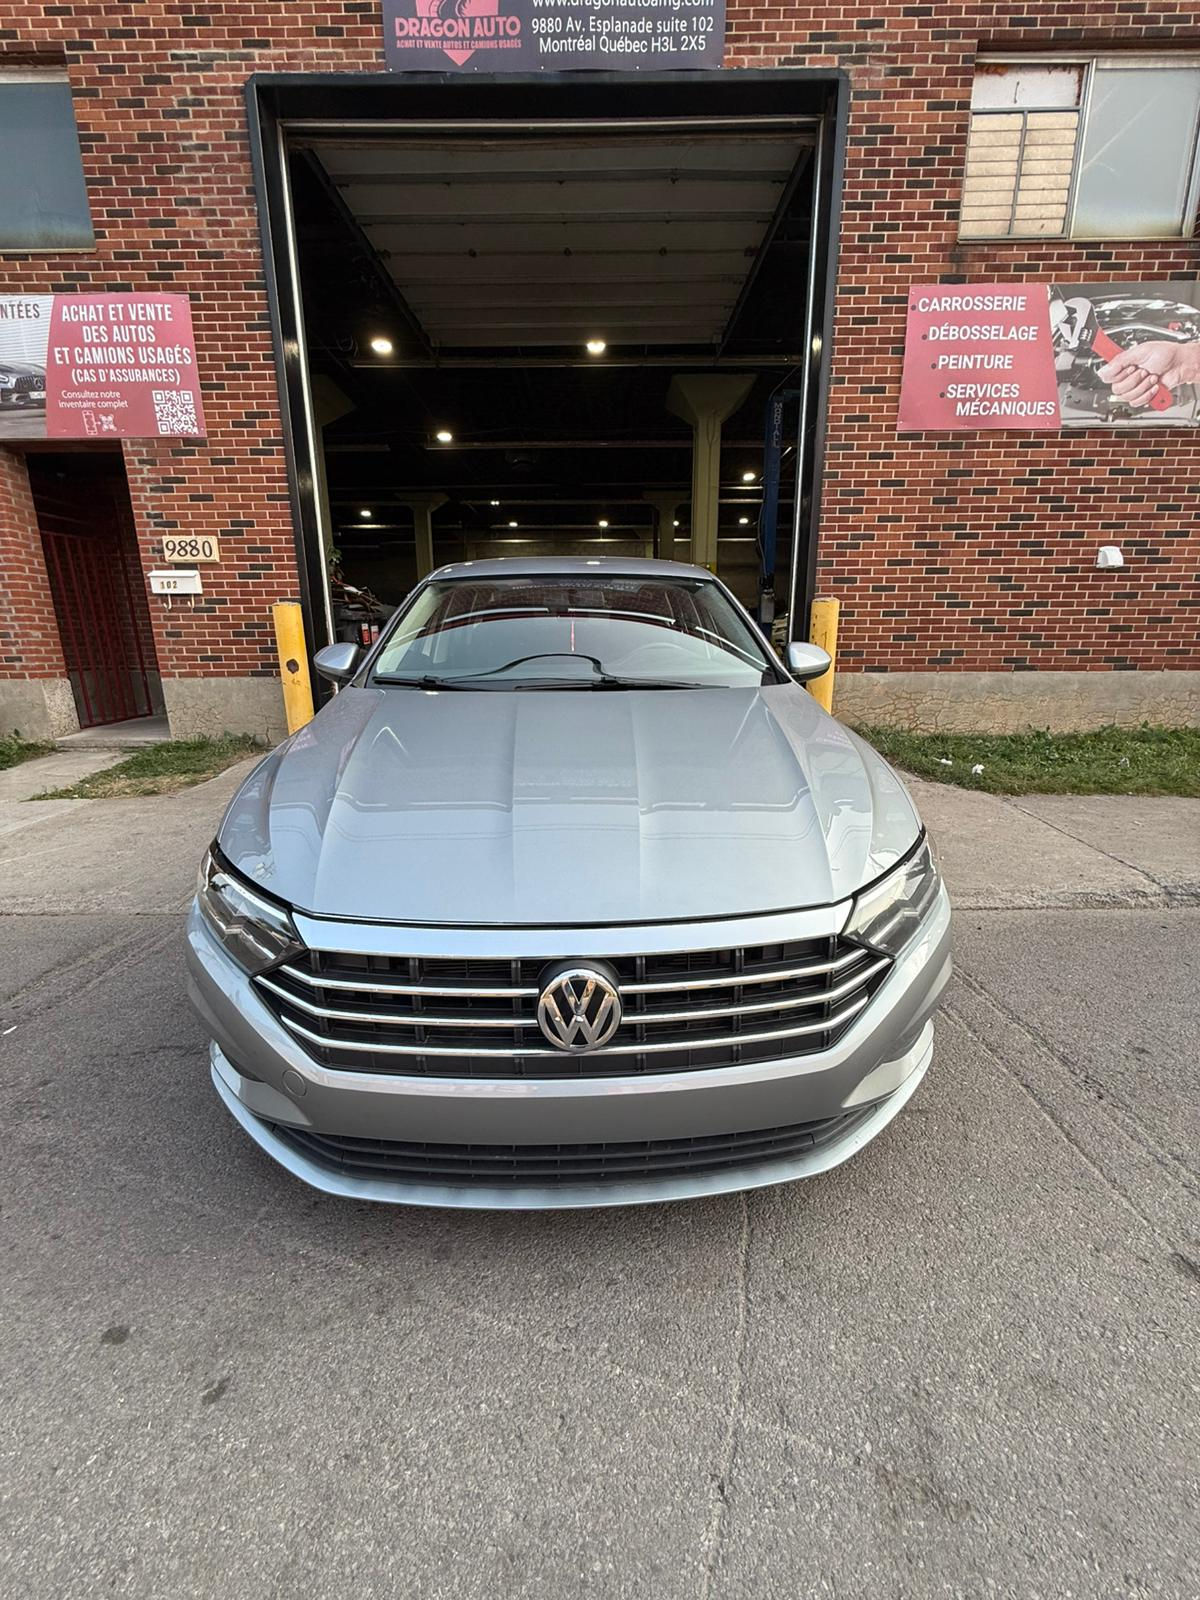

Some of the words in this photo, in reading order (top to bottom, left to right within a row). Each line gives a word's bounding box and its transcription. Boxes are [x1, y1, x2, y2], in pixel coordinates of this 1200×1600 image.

[394, 17, 470, 37] DRAGON
[473, 16, 521, 37] AUTO
[531, 17, 562, 34] 9880
[566, 16, 586, 32] Av.
[589, 16, 653, 36] Esplanade
[656, 17, 688, 33] suite
[691, 16, 714, 32] 102
[396, 40, 416, 48] ACHAT
[539, 35, 596, 53] Montréal
[600, 35, 648, 53] Québec
[651, 36, 677, 52] H3L
[681, 35, 706, 51] 2X5
[61, 304, 104, 322] ACHAT
[109, 304, 124, 321] ET
[128, 303, 173, 321] VENTE
[918, 296, 1027, 312] CARROSSERIE
[82, 325, 109, 343] DES
[113, 325, 156, 343] AUTOS
[928, 323, 1038, 341] DÉBOSSELAGE
[54, 347, 70, 364] ET
[75, 347, 135, 364] CAMIONS
[139, 344, 192, 364] USAGÉS
[938, 354, 1013, 369] PEINTURE
[72, 368, 96, 385] (CAS
[99, 368, 181, 385] D'ASSURANCES)
[61, 390, 98, 399] Consultez
[100, 391, 121, 399] notre
[946, 384, 1020, 398] SERVICES
[58, 400, 96, 408] inventaire
[97, 400, 129, 409] complet
[956, 399, 1055, 416] MÉCANIQUES
[165, 540, 213, 558] 9880
[160, 581, 178, 589] 102
[539, 970, 621, 1052] VW
